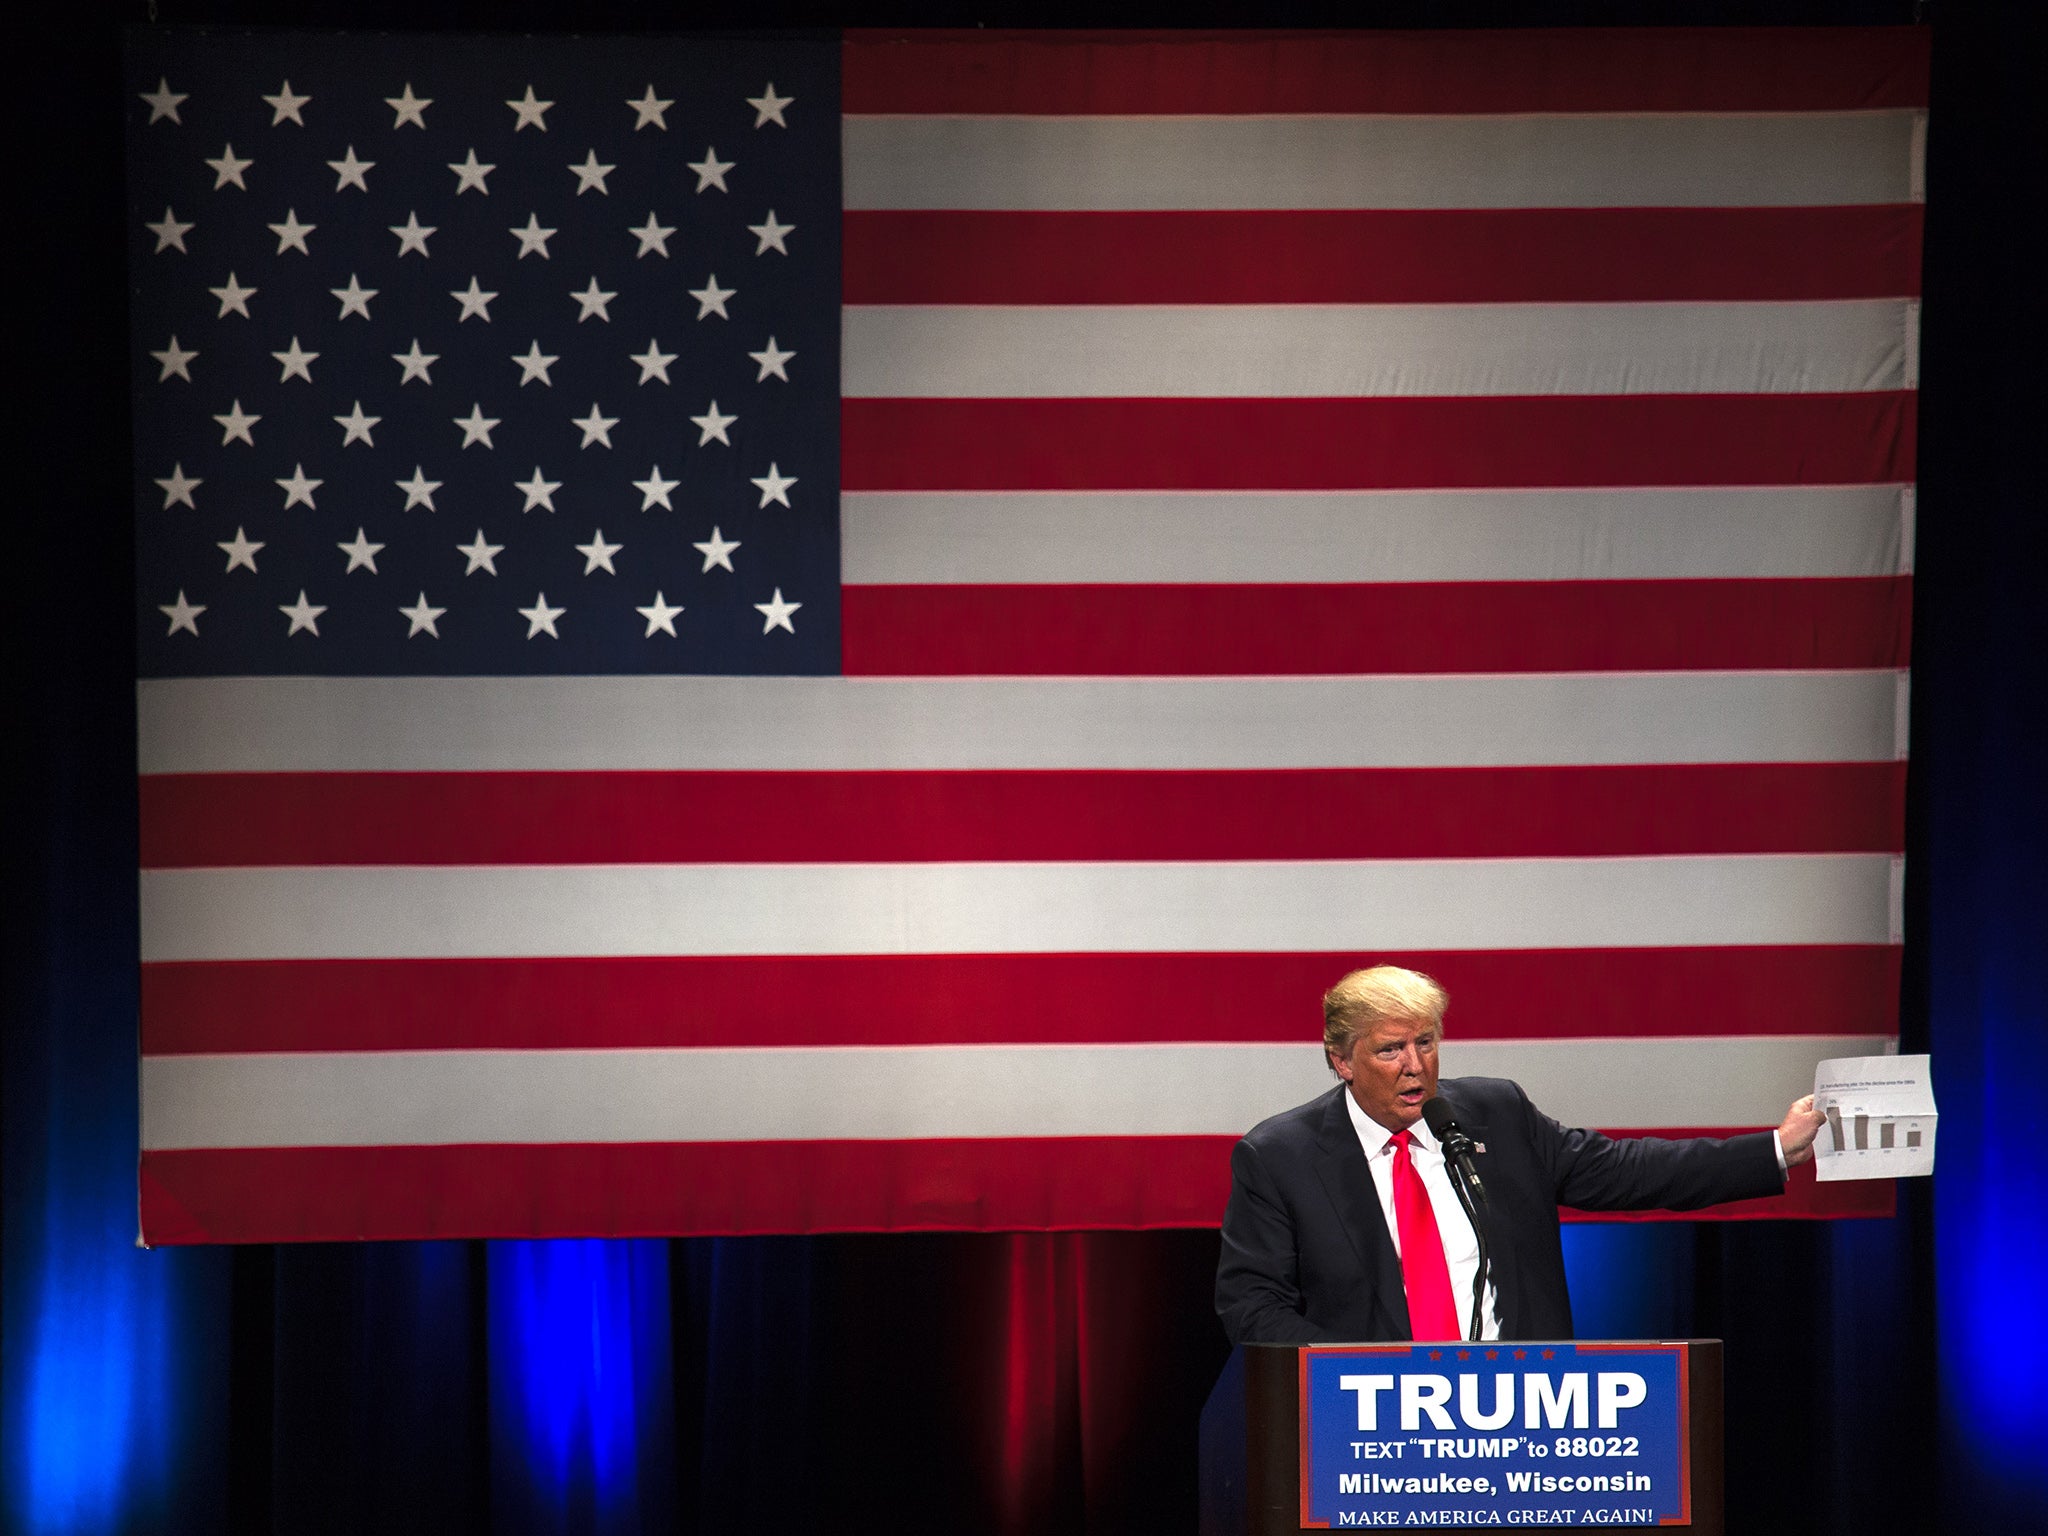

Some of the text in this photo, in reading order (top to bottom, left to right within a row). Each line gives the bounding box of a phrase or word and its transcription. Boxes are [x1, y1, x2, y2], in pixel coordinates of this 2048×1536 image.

[1339, 1372, 1647, 1431] TRUMP
[1350, 1441, 1407, 1459] TEXT
[1527, 1441, 1549, 1458] to
[1554, 1437, 1639, 1458] 88022
[1339, 1471, 1651, 1497] Milwaukee, Wisconsin
[1338, 1508, 1653, 1526] MAKE AMERICA GREAT AGAIN!
